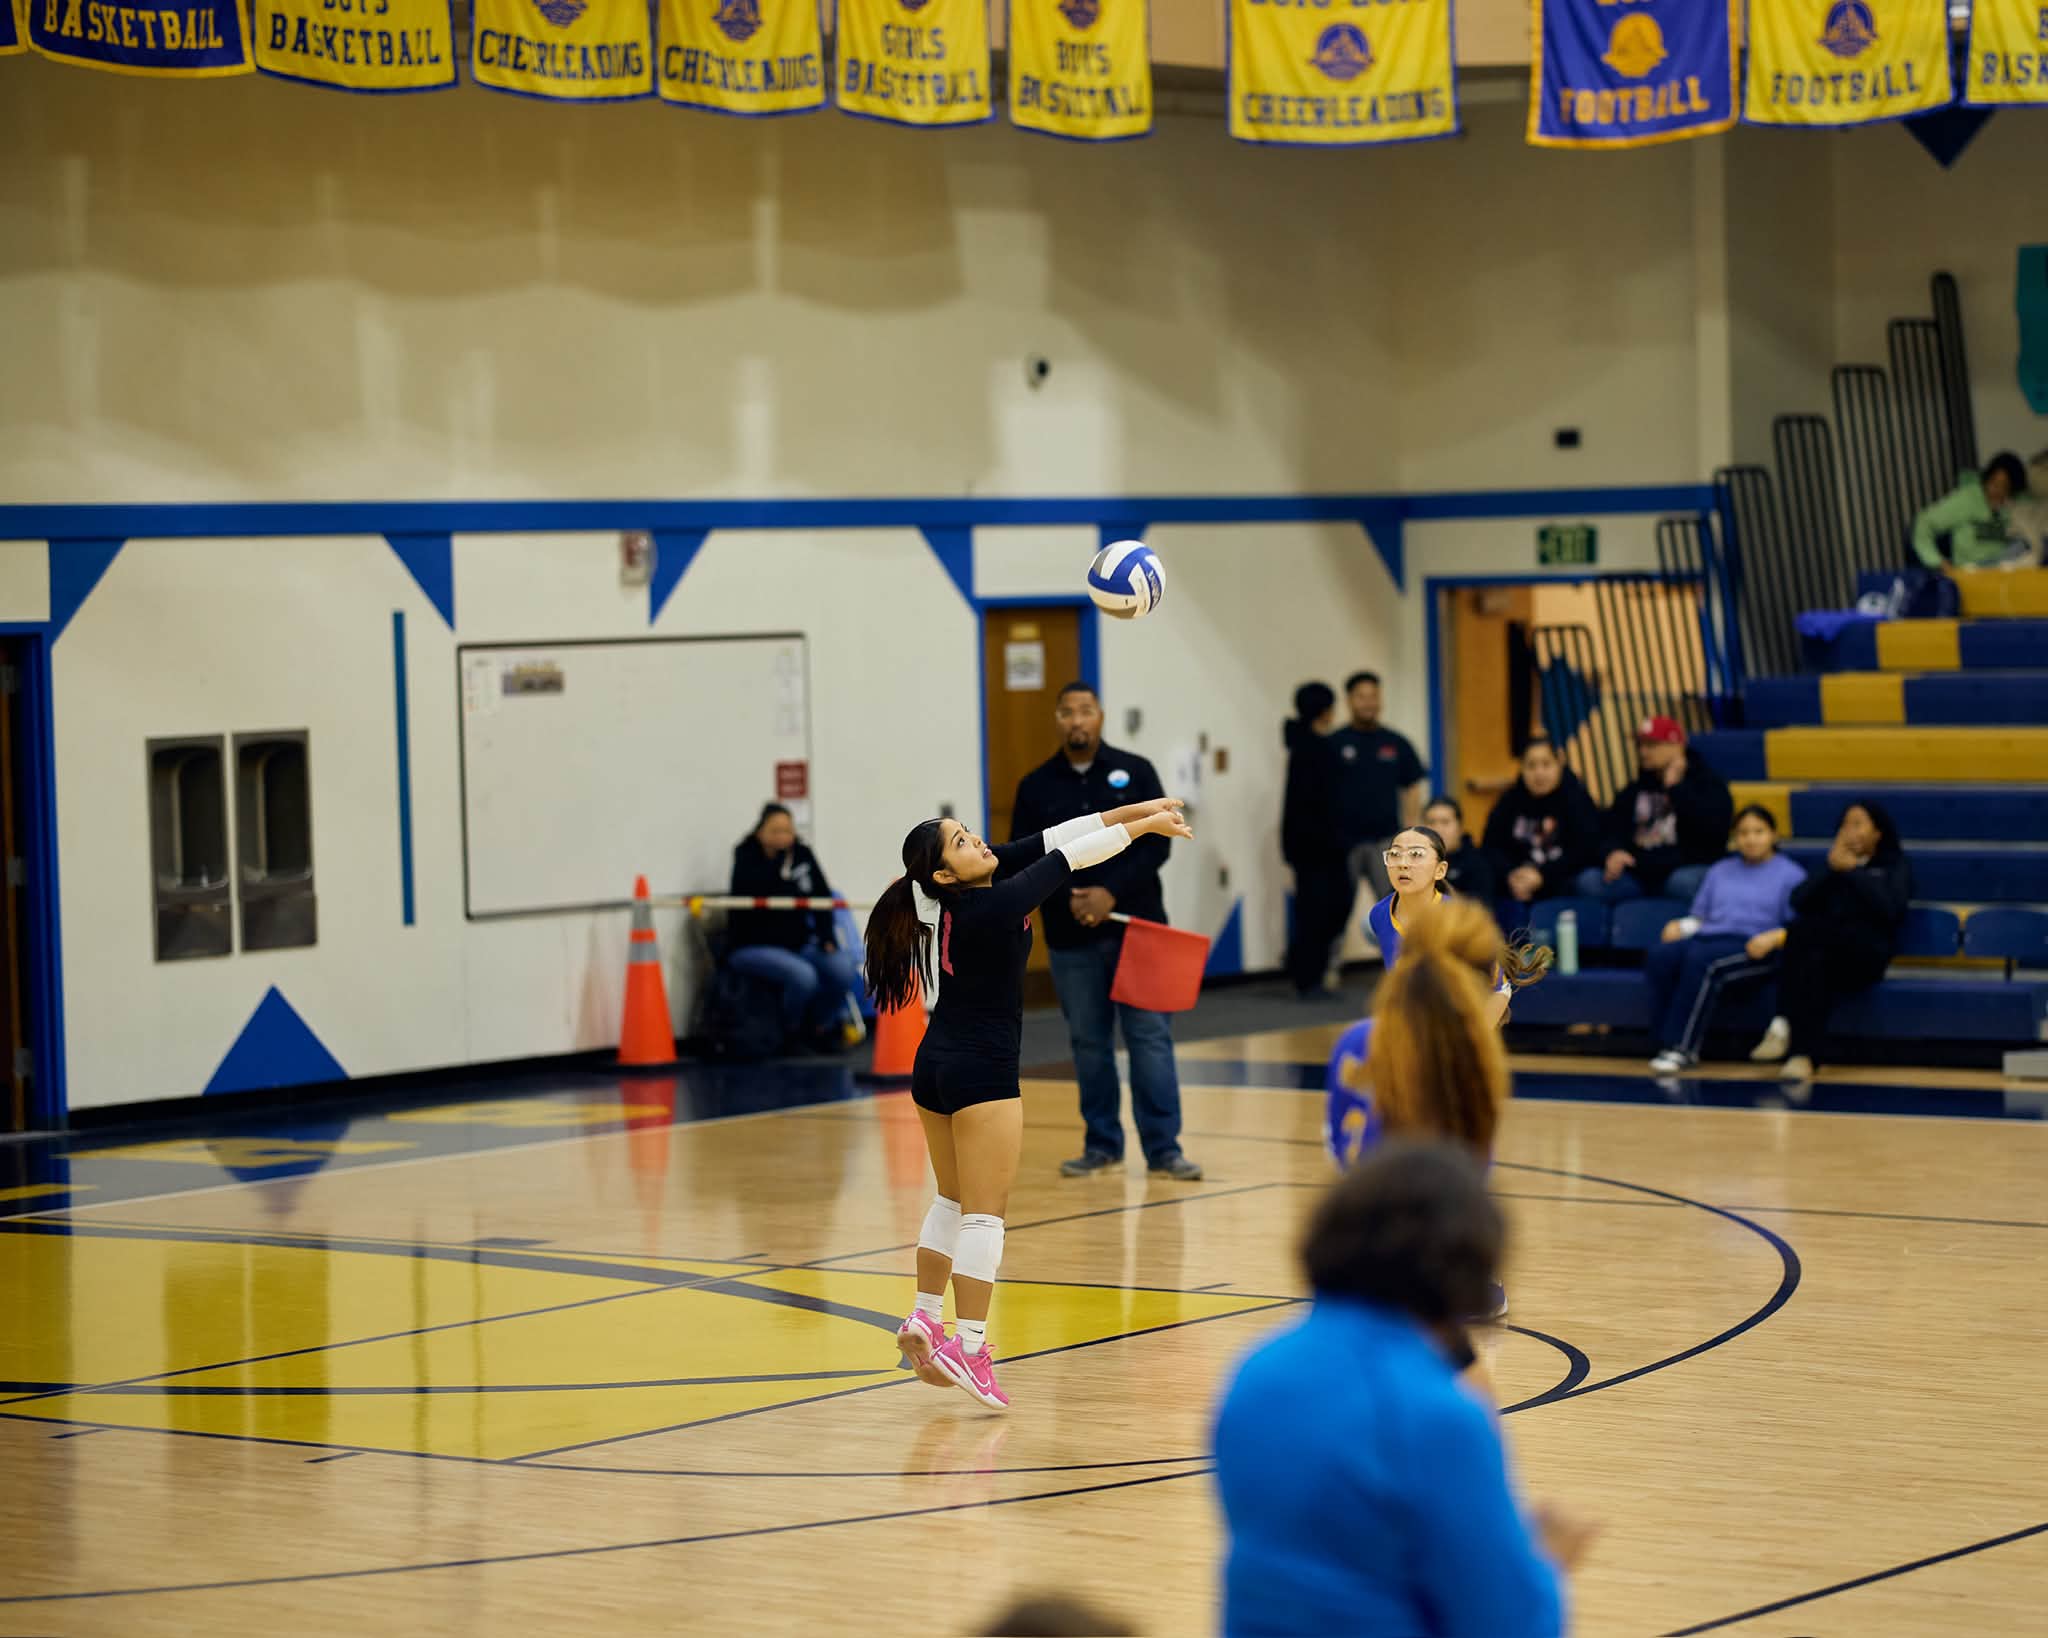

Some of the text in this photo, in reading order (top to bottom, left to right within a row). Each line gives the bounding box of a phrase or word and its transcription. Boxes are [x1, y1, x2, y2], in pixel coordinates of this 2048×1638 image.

[44, 0, 223, 49] BASKETBALL
[270, 13, 440, 66] BASKETBALL
[1560, 76, 1710, 124] FOOTBALL
[1771, 61, 1921, 105] FOOTBALL
